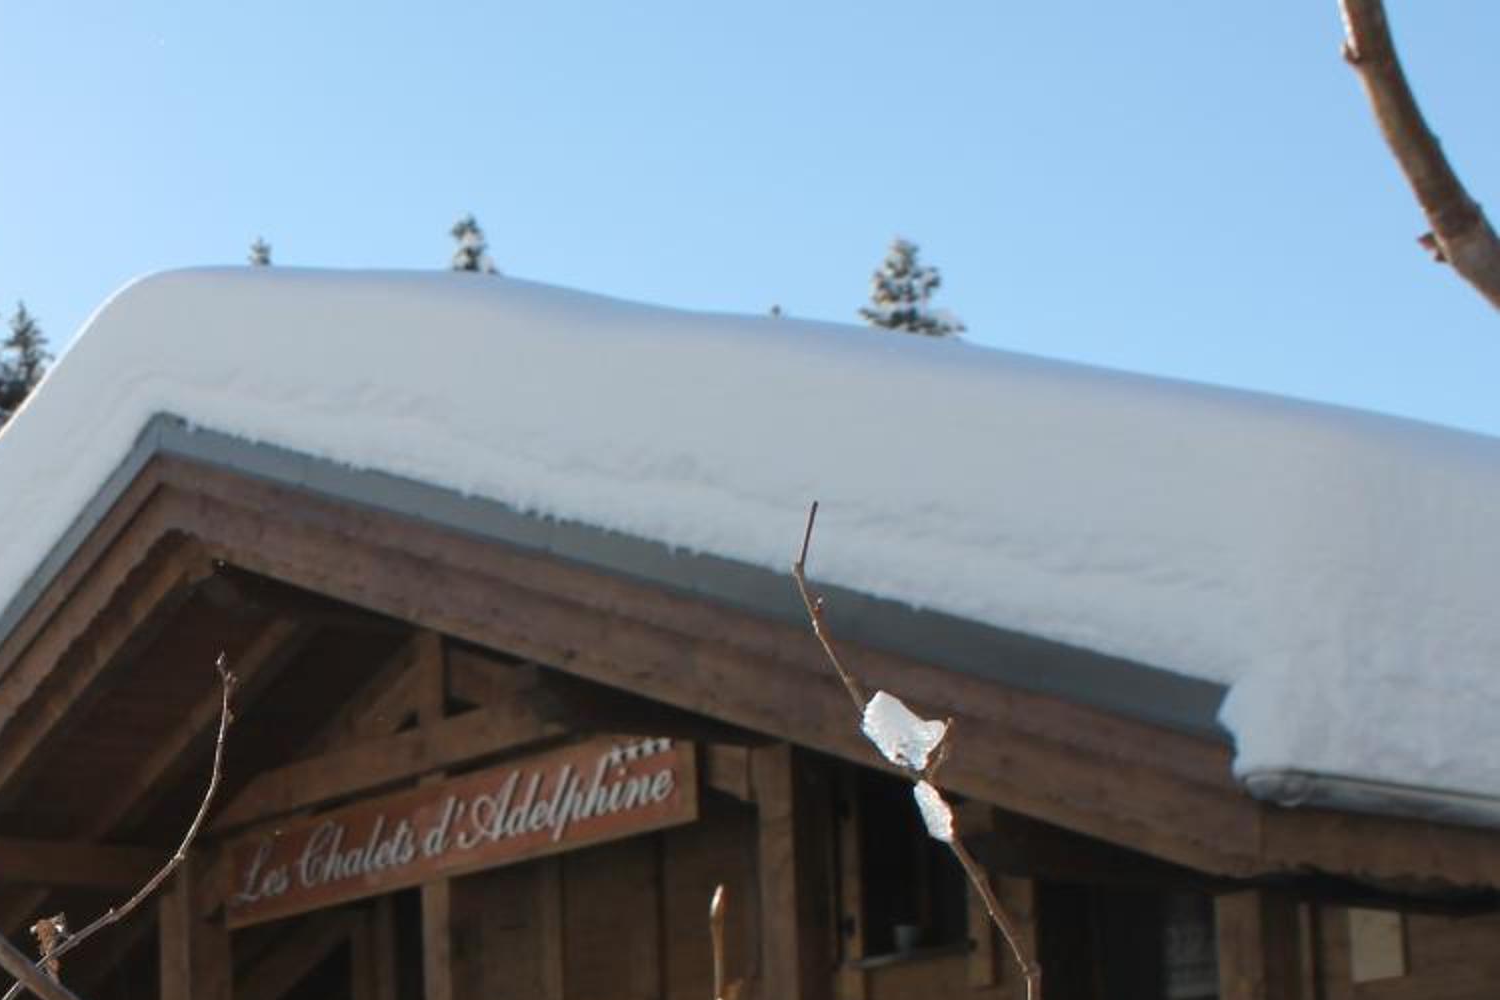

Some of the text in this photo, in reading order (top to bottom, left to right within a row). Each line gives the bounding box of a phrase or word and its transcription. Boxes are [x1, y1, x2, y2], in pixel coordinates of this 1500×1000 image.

[234, 751, 674, 902] Les Chalets d'Adelphine
